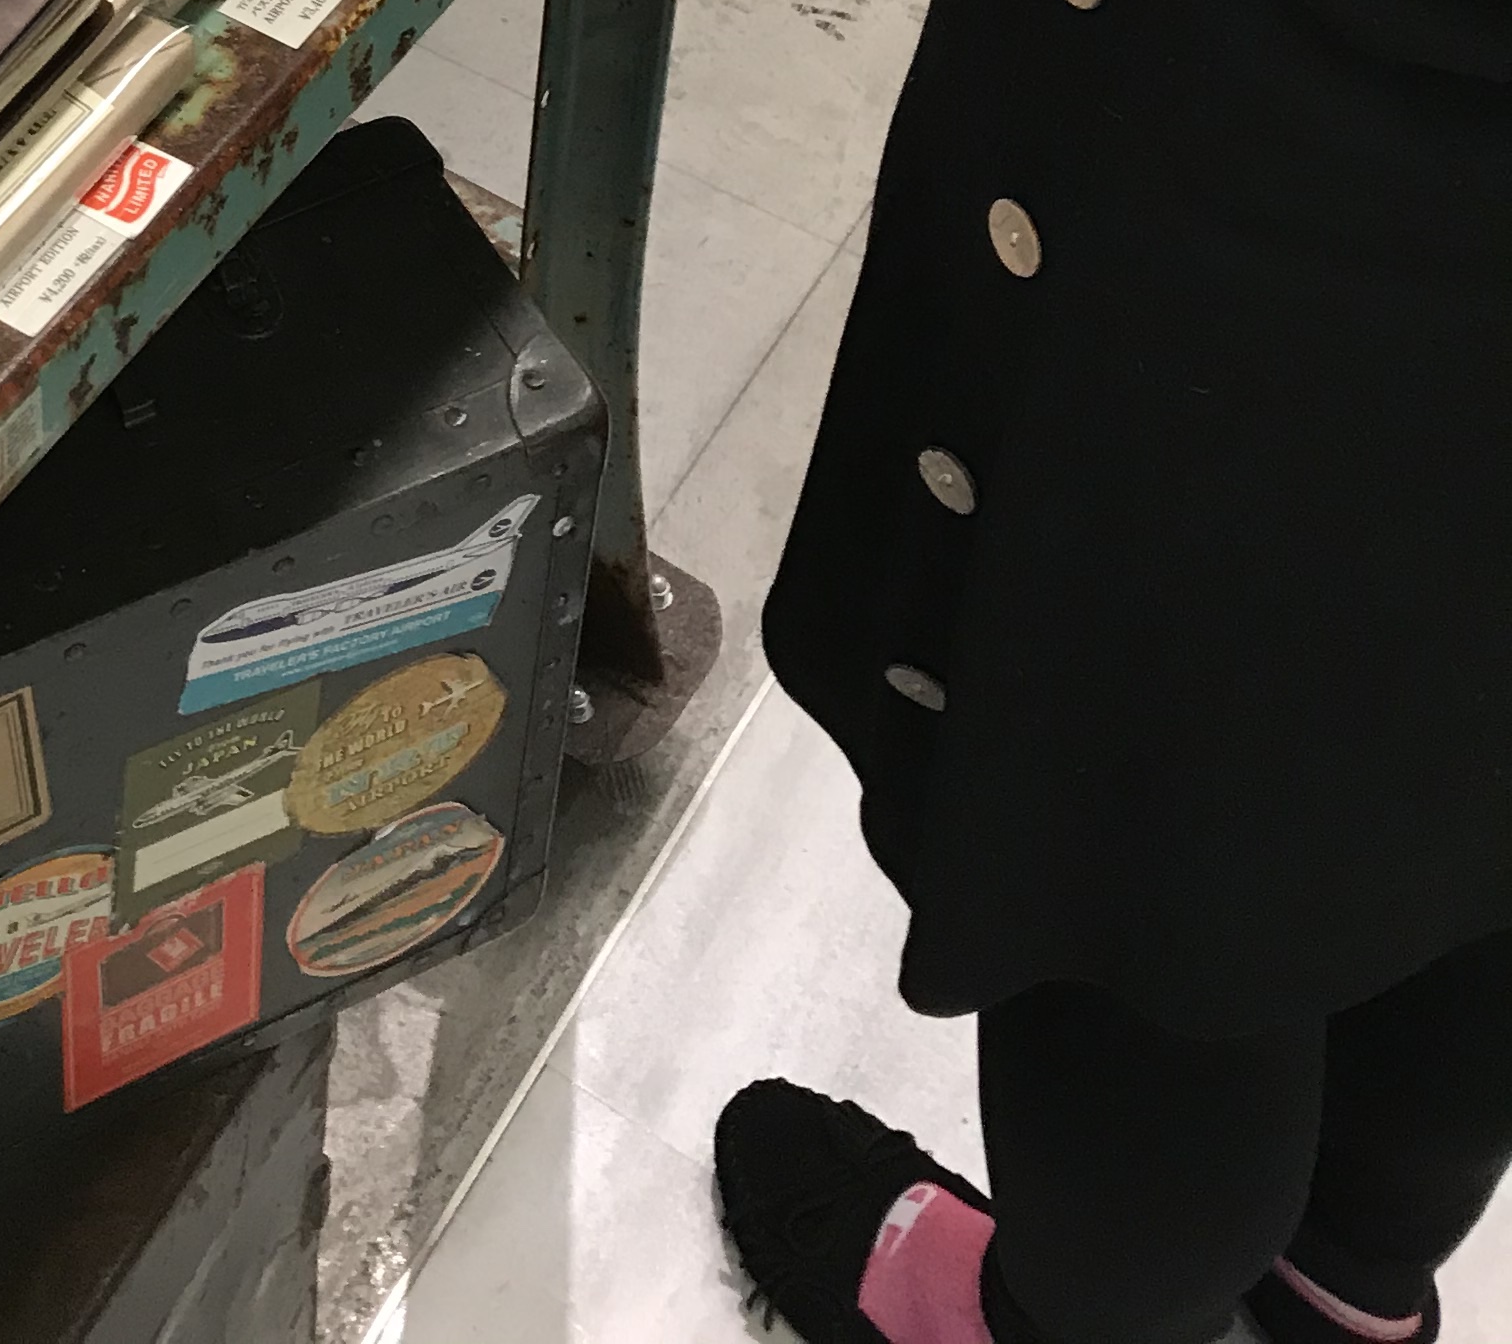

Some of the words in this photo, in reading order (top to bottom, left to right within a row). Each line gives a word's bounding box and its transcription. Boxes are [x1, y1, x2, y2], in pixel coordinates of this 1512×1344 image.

[123, 157, 158, 216] LIMITED
[0, 264, 43, 309] AIRPORT
[38, 225, 80, 267] EDITION
[37, 267, 76, 304] ¥4,200
[183, 734, 260, 776] JAPAN
[348, 718, 408, 756] WORLD
